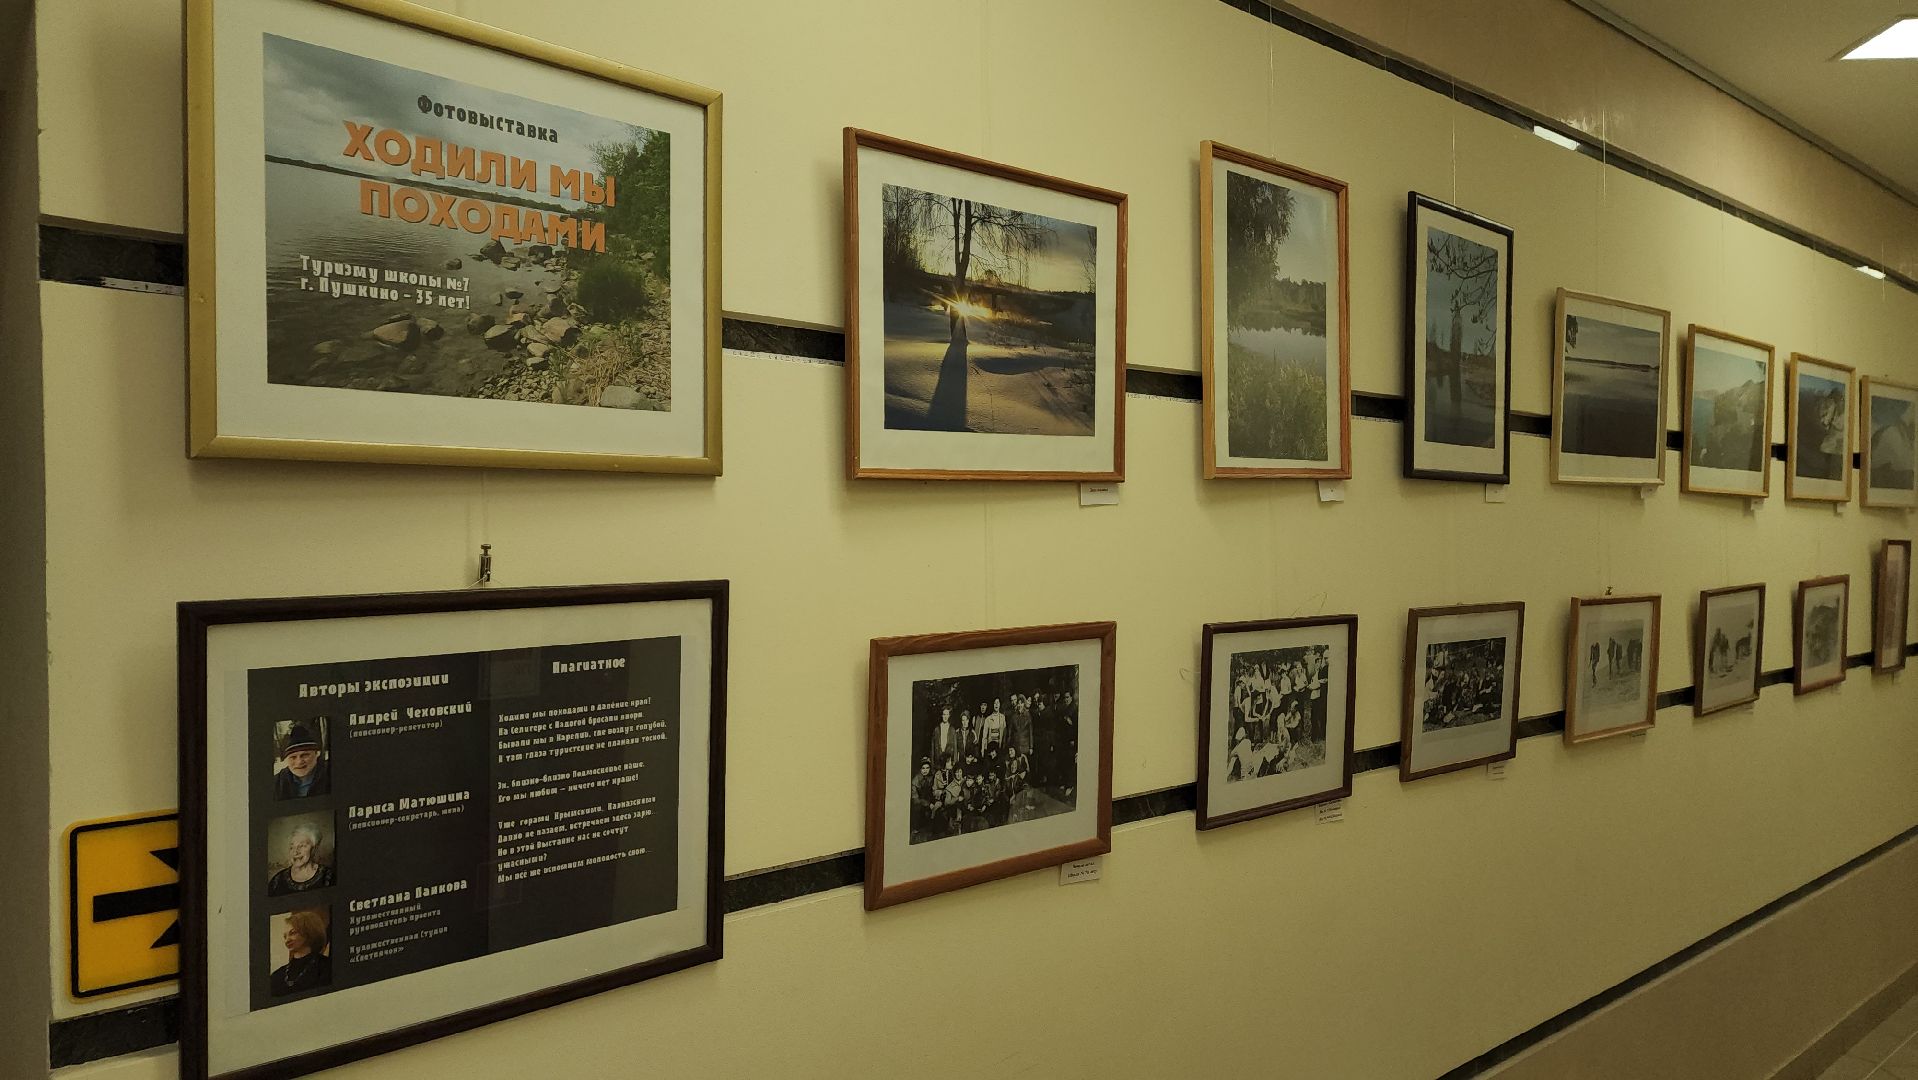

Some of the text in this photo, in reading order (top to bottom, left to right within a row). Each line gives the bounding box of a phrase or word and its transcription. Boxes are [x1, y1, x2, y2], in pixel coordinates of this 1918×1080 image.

[417, 94, 559, 143] Фотовыставка
[342, 119, 616, 207] ХОДИЛИ МЫ
[360, 180, 606, 253] ПОХОДАМИ
[300, 254, 470, 292] Туризму школы №7
[300, 277, 314, 291] г.
[319, 276, 400, 301] Пушкино
[415, 288, 433, 306] 35
[438, 294, 470, 310] лет!
[551, 657, 626, 674] Плагиатное
[298, 673, 450, 699] Авторы экспозиции
[349, 701, 472, 726] Андрей Чеховский
[498, 712, 530, 723] Ходили
[532, 710, 546, 719] мы
[549, 705, 588, 717] походами
[630, 696, 651, 708] края!
[498, 727, 509, 737] На
[510, 724, 547, 734] Селигере
[554, 717, 586, 729] Ладогой
[587, 714, 619, 726] бросали
[498, 739, 531, 750] Бывали
[533, 737, 547, 745] мы
[593, 729, 606, 737] где
[607, 725, 634, 735] воздух
[505, 753, 523, 762] там
[525, 750, 547, 760] глаза
[595, 742, 606, 750] не
[572, 764, 622, 778] Подмосковье
[498, 794, 511, 803] Его
[513, 792, 527, 801] мы
[529, 787, 558, 798] любим
[568, 781, 595, 792] ничего
[596, 779, 610, 787] нет
[612, 773, 639, 786] краше!
[348, 790, 470, 819] Лариса Матюшина
[498, 820, 516, 830] Уже
[519, 815, 550, 826] горами
[497, 832, 523, 844] Давно
[525, 830, 535, 838] не
[497, 847, 508, 857] Но
[516, 842, 535, 854] этой
[536, 836, 575, 849] Выставке
[577, 833, 590, 842] нас
[592, 831, 601, 839] не
[602, 825, 629, 837] сочтут
[497, 852, 548, 872] ужасными?
[497, 873, 513, 884] Мы
[529, 868, 541, 877] же
[585, 851, 627, 866] молодость
[349, 879, 467, 912] Светлана Панкова
